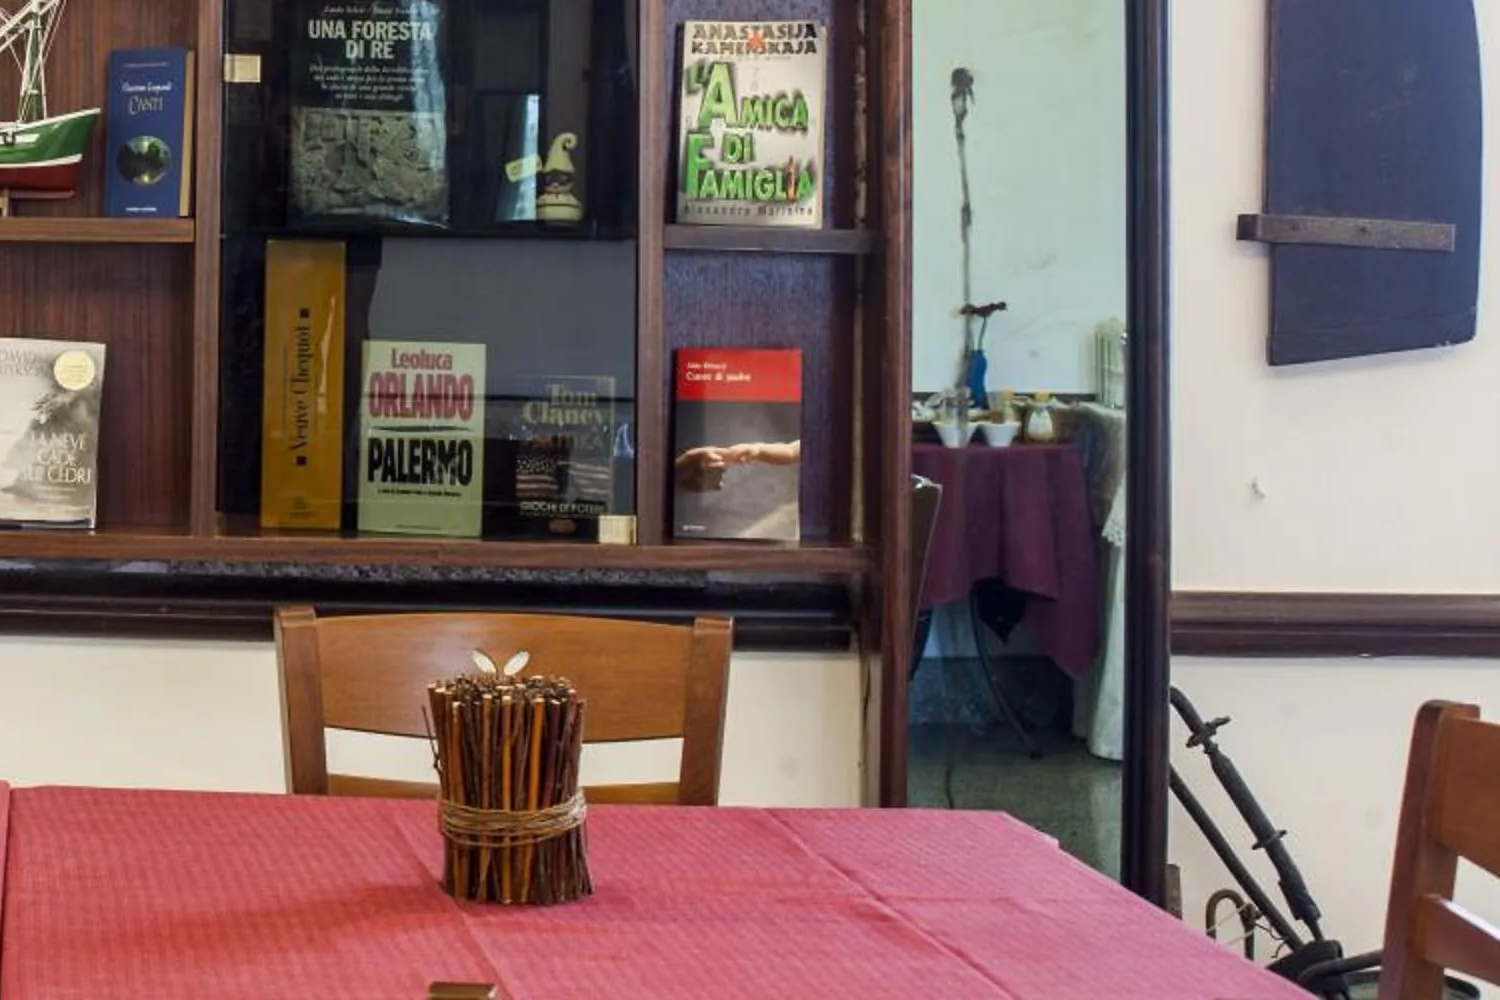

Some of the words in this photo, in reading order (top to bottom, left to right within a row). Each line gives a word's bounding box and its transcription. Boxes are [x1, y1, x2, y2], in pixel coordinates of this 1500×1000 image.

[308, 19, 347, 40] UNA
[352, 20, 432, 41] FORESTA
[692, 23, 818, 39] ANASTASIJA
[345, 39, 365, 59] DI
[370, 40, 396, 59] RE
[723, 132, 754, 163] DI
[290, 325, 314, 396] Clicquot
[391, 347, 453, 371] Leoluca
[368, 371, 475, 422] ORLANDO
[547, 383, 598, 407] Tom
[288, 400, 309, 452] Veuve
[368, 437, 474, 487] PALERMO
